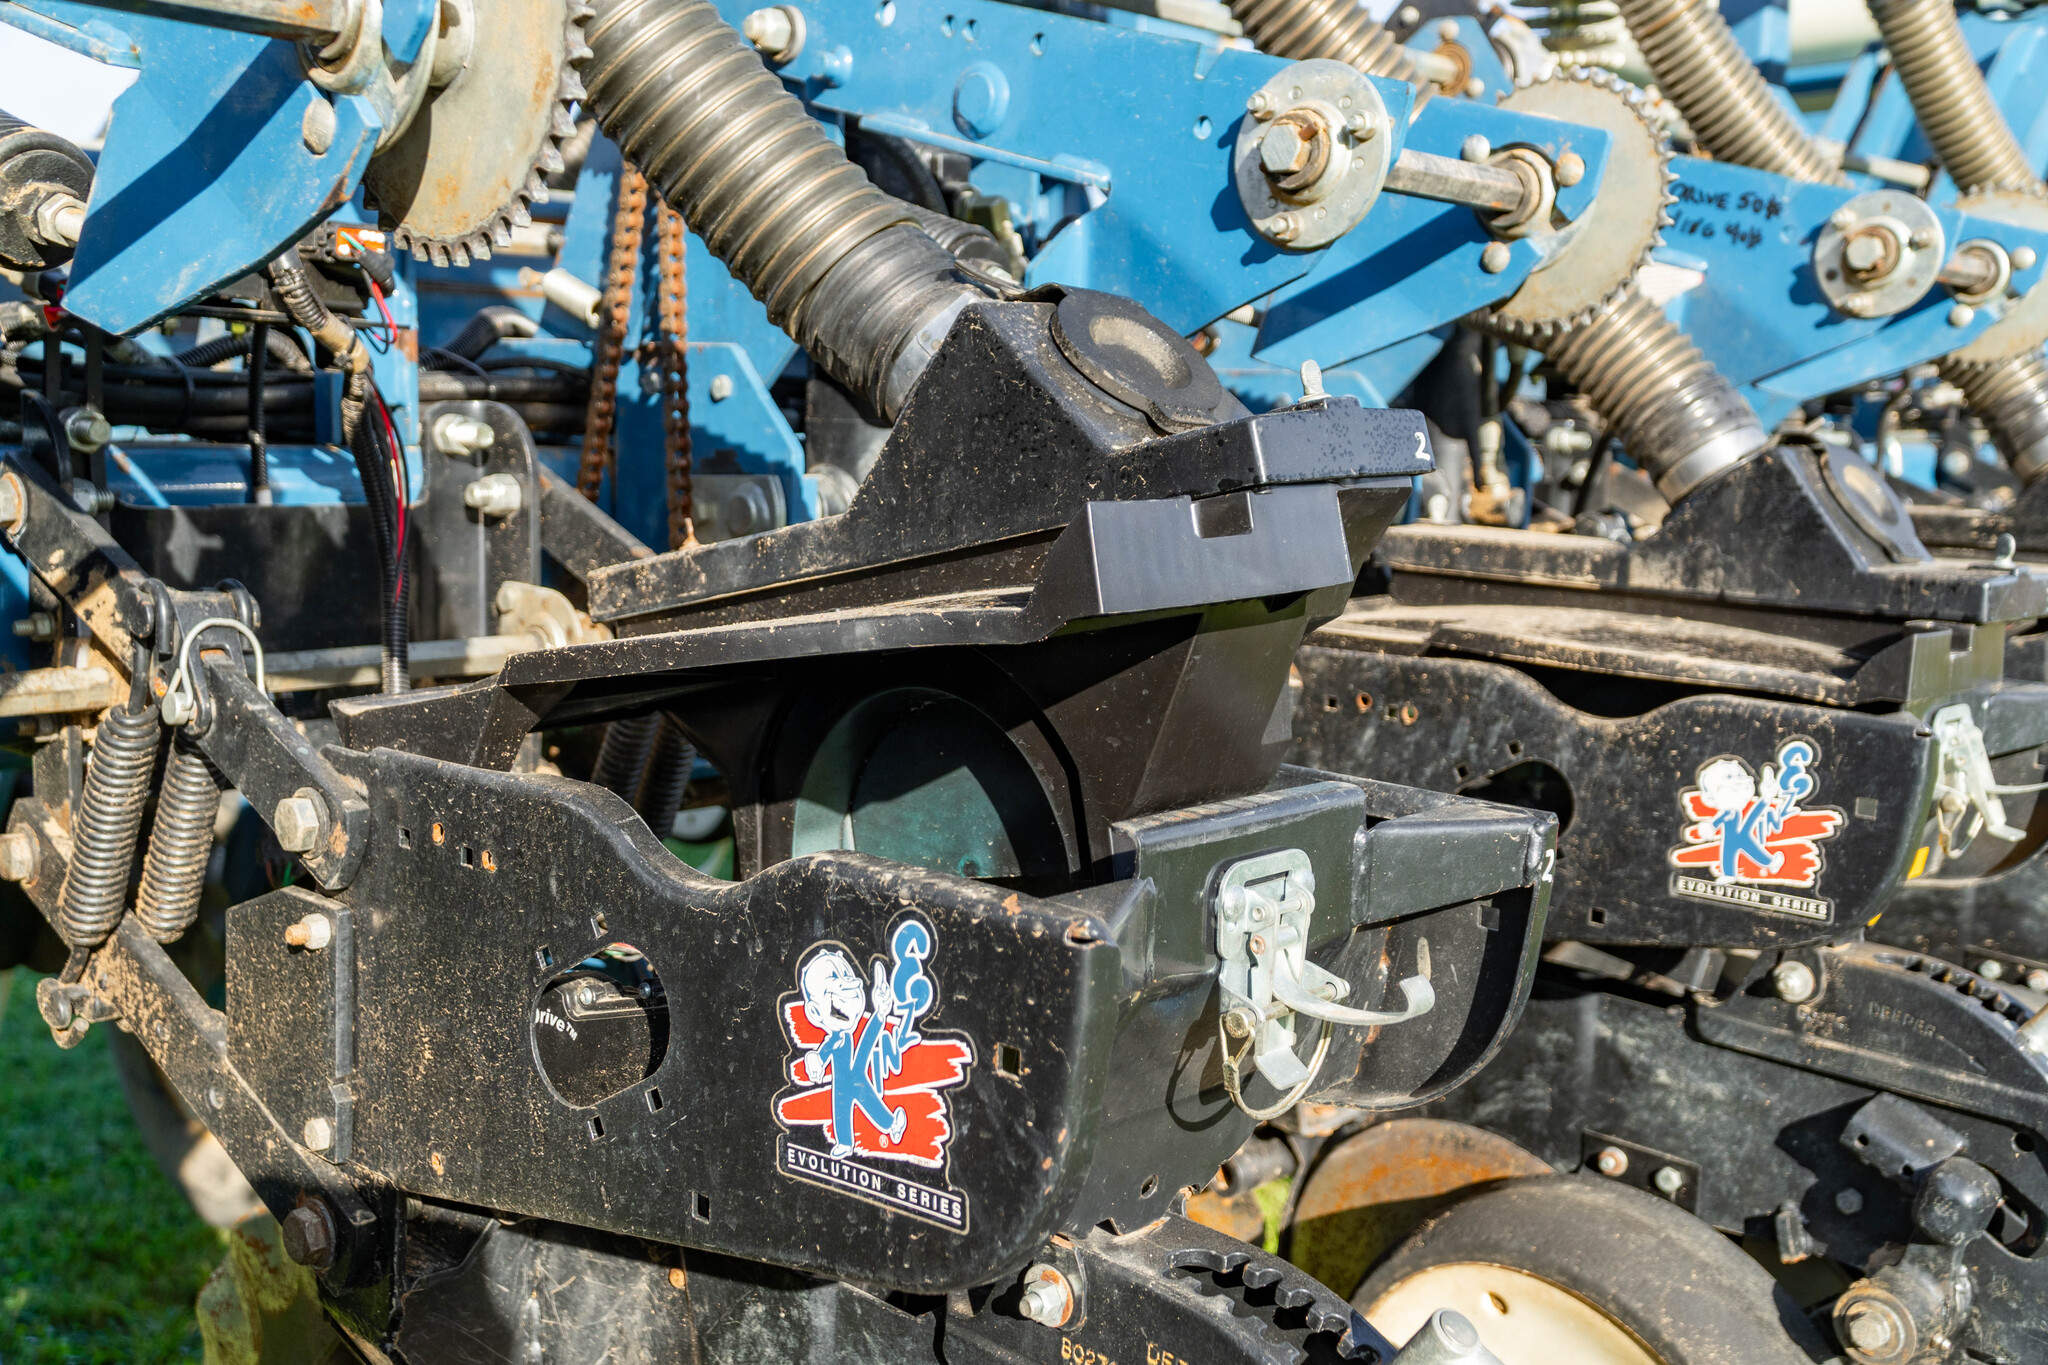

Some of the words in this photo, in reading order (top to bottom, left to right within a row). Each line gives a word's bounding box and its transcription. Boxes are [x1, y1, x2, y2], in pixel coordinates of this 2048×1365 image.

[1414, 431, 1431, 461] 2
[1541, 848, 1555, 883] 2
[1678, 878, 1760, 902] EVOLUTION
[1771, 896, 1828, 914] SERIES
[787, 1147, 881, 1191] EVOLUTION
[896, 1183, 962, 1218] SERIES
